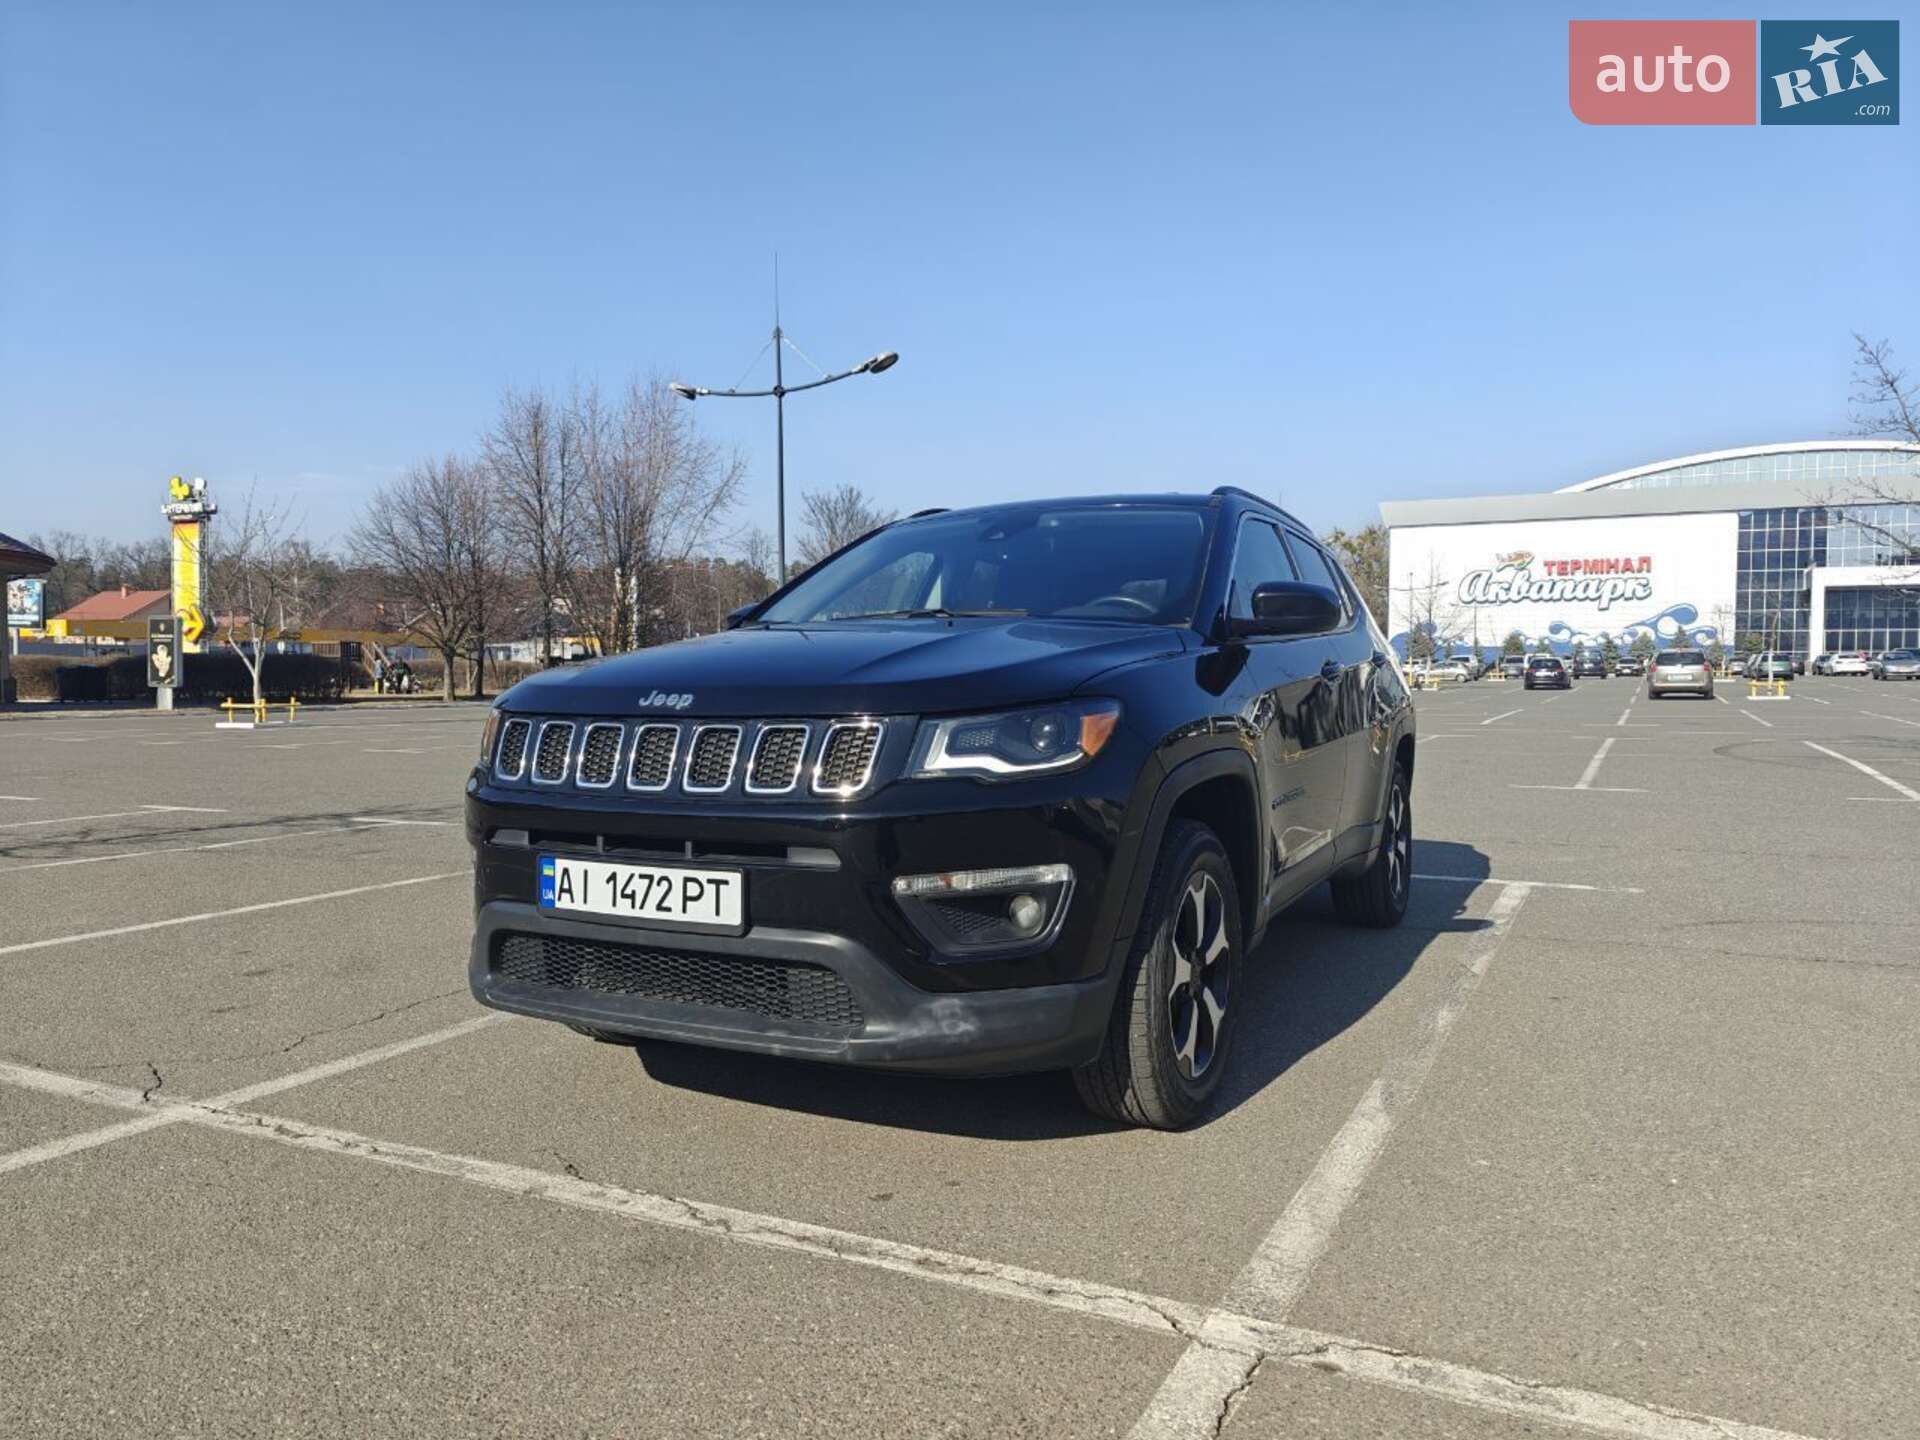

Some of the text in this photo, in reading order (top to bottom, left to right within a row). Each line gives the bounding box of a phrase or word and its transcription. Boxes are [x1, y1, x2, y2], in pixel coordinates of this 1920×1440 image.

[1543, 556, 1652, 577] ТЕРМІНАЛ
[1458, 568, 1653, 611] Аквапарк
[638, 690, 694, 710] Jeep
[557, 867, 730, 917] AI 1472 PT
